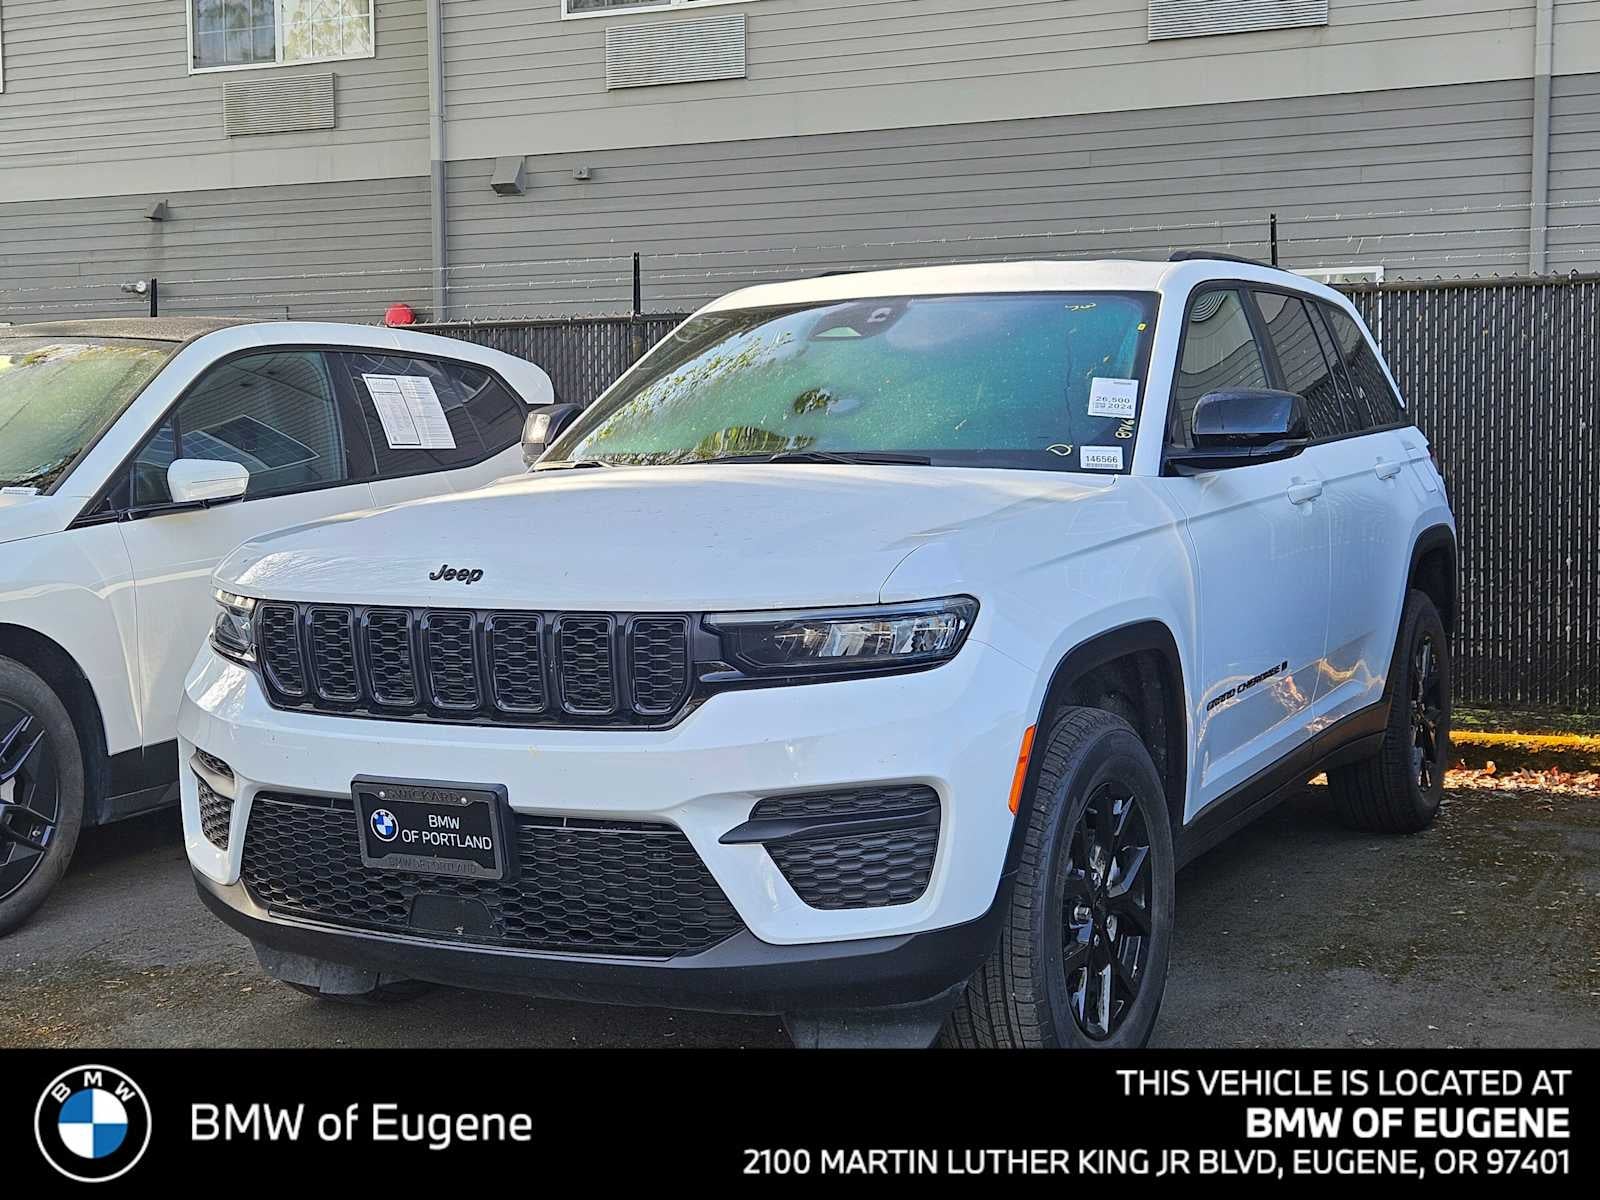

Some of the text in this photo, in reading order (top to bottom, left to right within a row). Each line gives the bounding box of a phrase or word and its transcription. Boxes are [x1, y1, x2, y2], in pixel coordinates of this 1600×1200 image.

[429, 564, 484, 585] Jeep
[428, 814, 460, 830] BMW
[401, 829, 492, 850] OF PORTLAND
